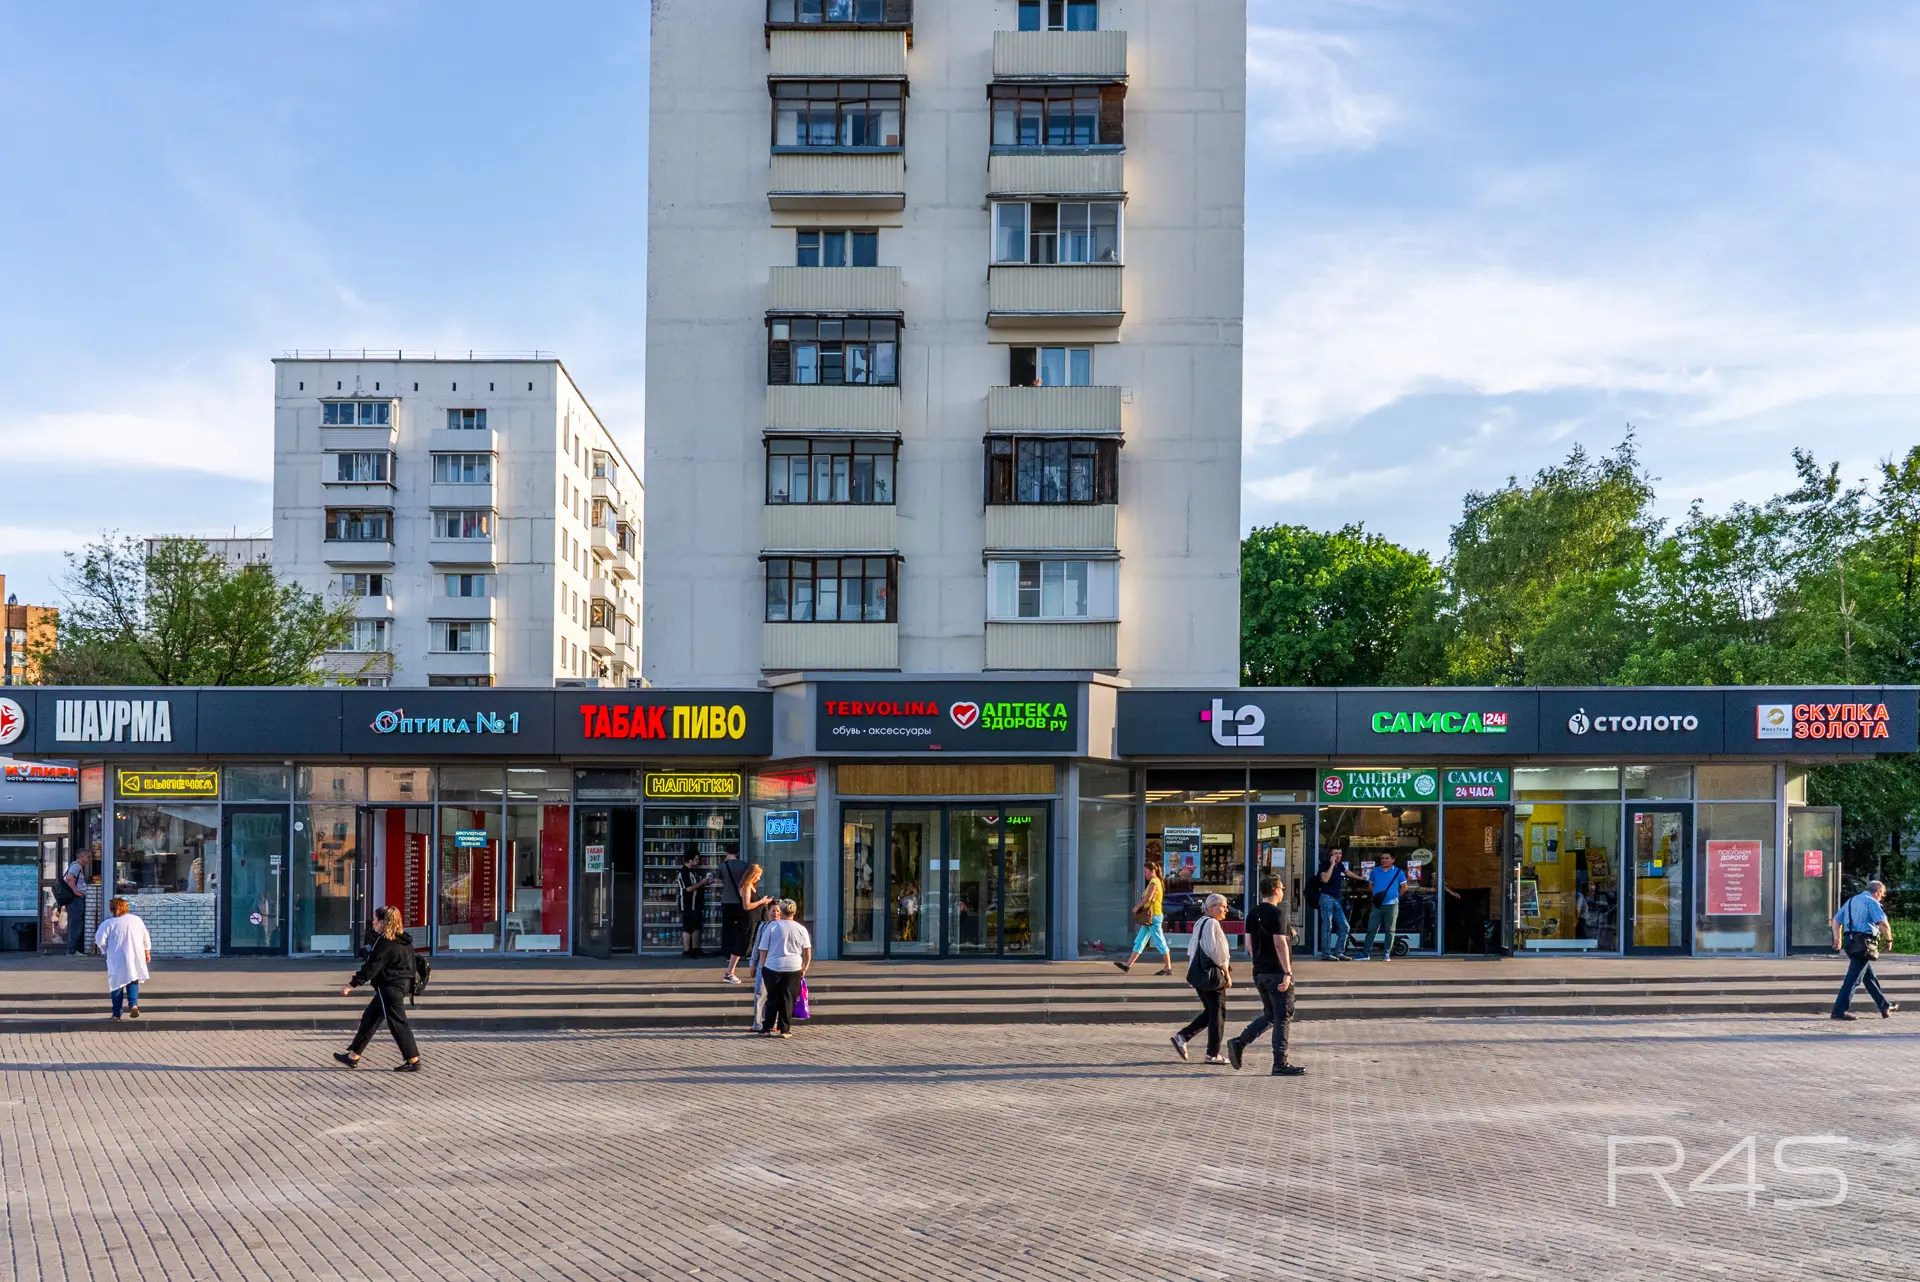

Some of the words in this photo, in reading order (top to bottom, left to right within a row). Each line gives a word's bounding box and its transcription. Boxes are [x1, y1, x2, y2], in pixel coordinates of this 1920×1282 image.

[824, 701, 939, 716] TERVOLINA
[981, 702, 1068, 718] АПТЕКА
[1794, 703, 1890, 721] СКУПКА
[56, 699, 172, 742] ШАУРМА
[580, 704, 667, 739] ТАБАК
[672, 704, 747, 740] ПИВО
[1211, 698, 1265, 747] t2
[1371, 711, 1485, 733] САМСА
[1594, 715, 1699, 732] СТОЛОТО
[832, 726, 861, 736] обувь
[868, 726, 932, 736] аксессуары
[1794, 721, 1890, 739] ЗОЛОТА
[144, 778, 214, 790] ВЫПЕЧКА
[1326, 779, 1341, 789] 24
[1346, 772, 1412, 787] ТАНДЫР
[1447, 771, 1504, 784] САМСА
[652, 778, 734, 793] НАПИТКИ
[1352, 786, 1406, 799] САМСА
[1455, 787, 1467, 797] 24
[1469, 787, 1495, 797] ЧАСА
[767, 818, 797, 836] ОБУВЬ
